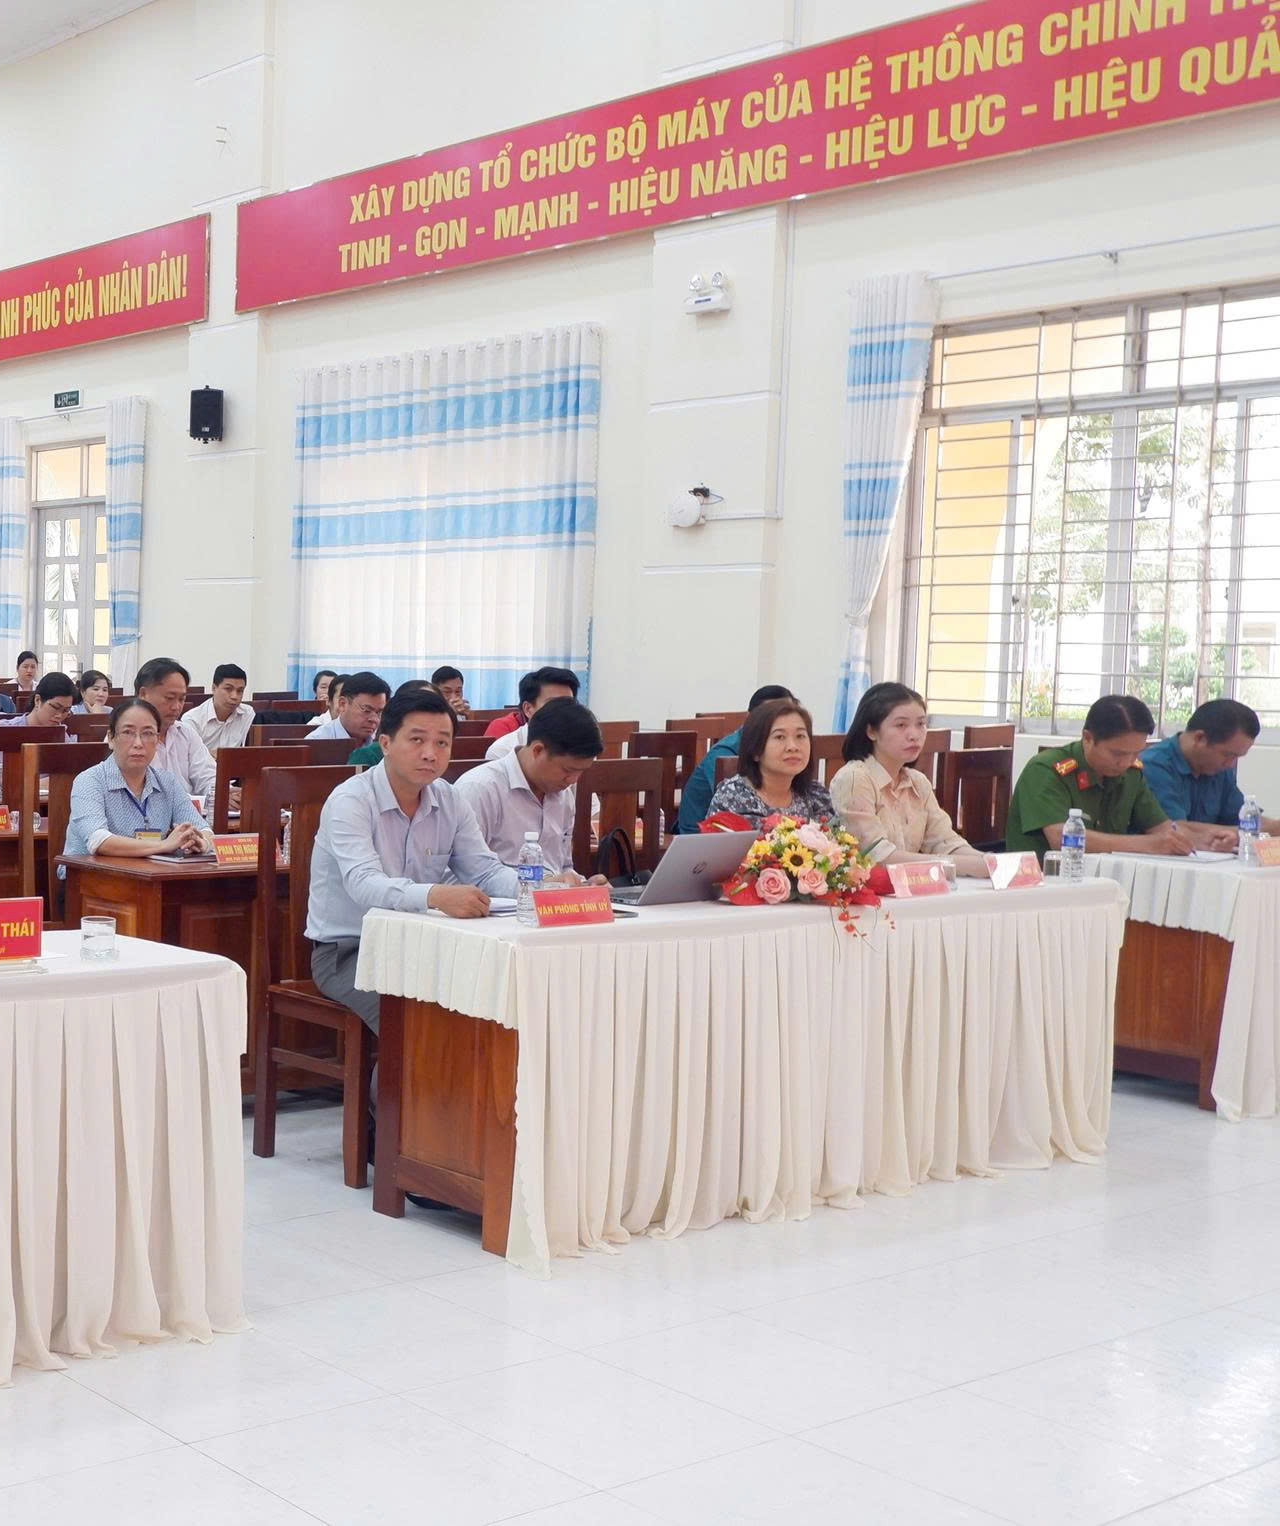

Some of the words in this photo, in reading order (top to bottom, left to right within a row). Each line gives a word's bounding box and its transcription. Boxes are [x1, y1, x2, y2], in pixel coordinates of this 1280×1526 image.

[337, 233, 392, 274] TINH
[398, 243, 408, 253] -
[414, 216, 468, 261] GỌN
[474, 225, 486, 236] -
[493, 190, 579, 241] MẠNH
[587, 200, 600, 210] -
[608, 165, 681, 217] HIỆU
[689, 143, 788, 199] NĂNG
[798, 153, 814, 165] -
[824, 113, 914, 171] HIỆU
[926, 93, 1007, 151] LỰC
[1021, 103, 1038, 116] -
[1052, 56, 1162, 121] HIỆU
[1178, 14, 1280, 97] QUẢ
[348, 183, 396, 225] XÂY
[401, 165, 472, 215] DỰNG
[478, 141, 514, 193] TỔ
[519, 131, 597, 183] CHỨC
[605, 113, 648, 164] BỘ
[656, 96, 732, 151] MÁY
[740, 71, 813, 129] CỦA
[824, 54, 873, 111] HỆ
[885, 22, 1025, 95] THỐNG
[22, 280, 61, 335] PHÚC
[64, 266, 95, 326] CỦA
[97, 259, 144, 318] NHÂN
[146, 250, 189, 306] DÂN!
[0, 918, 35, 939] THÁI
